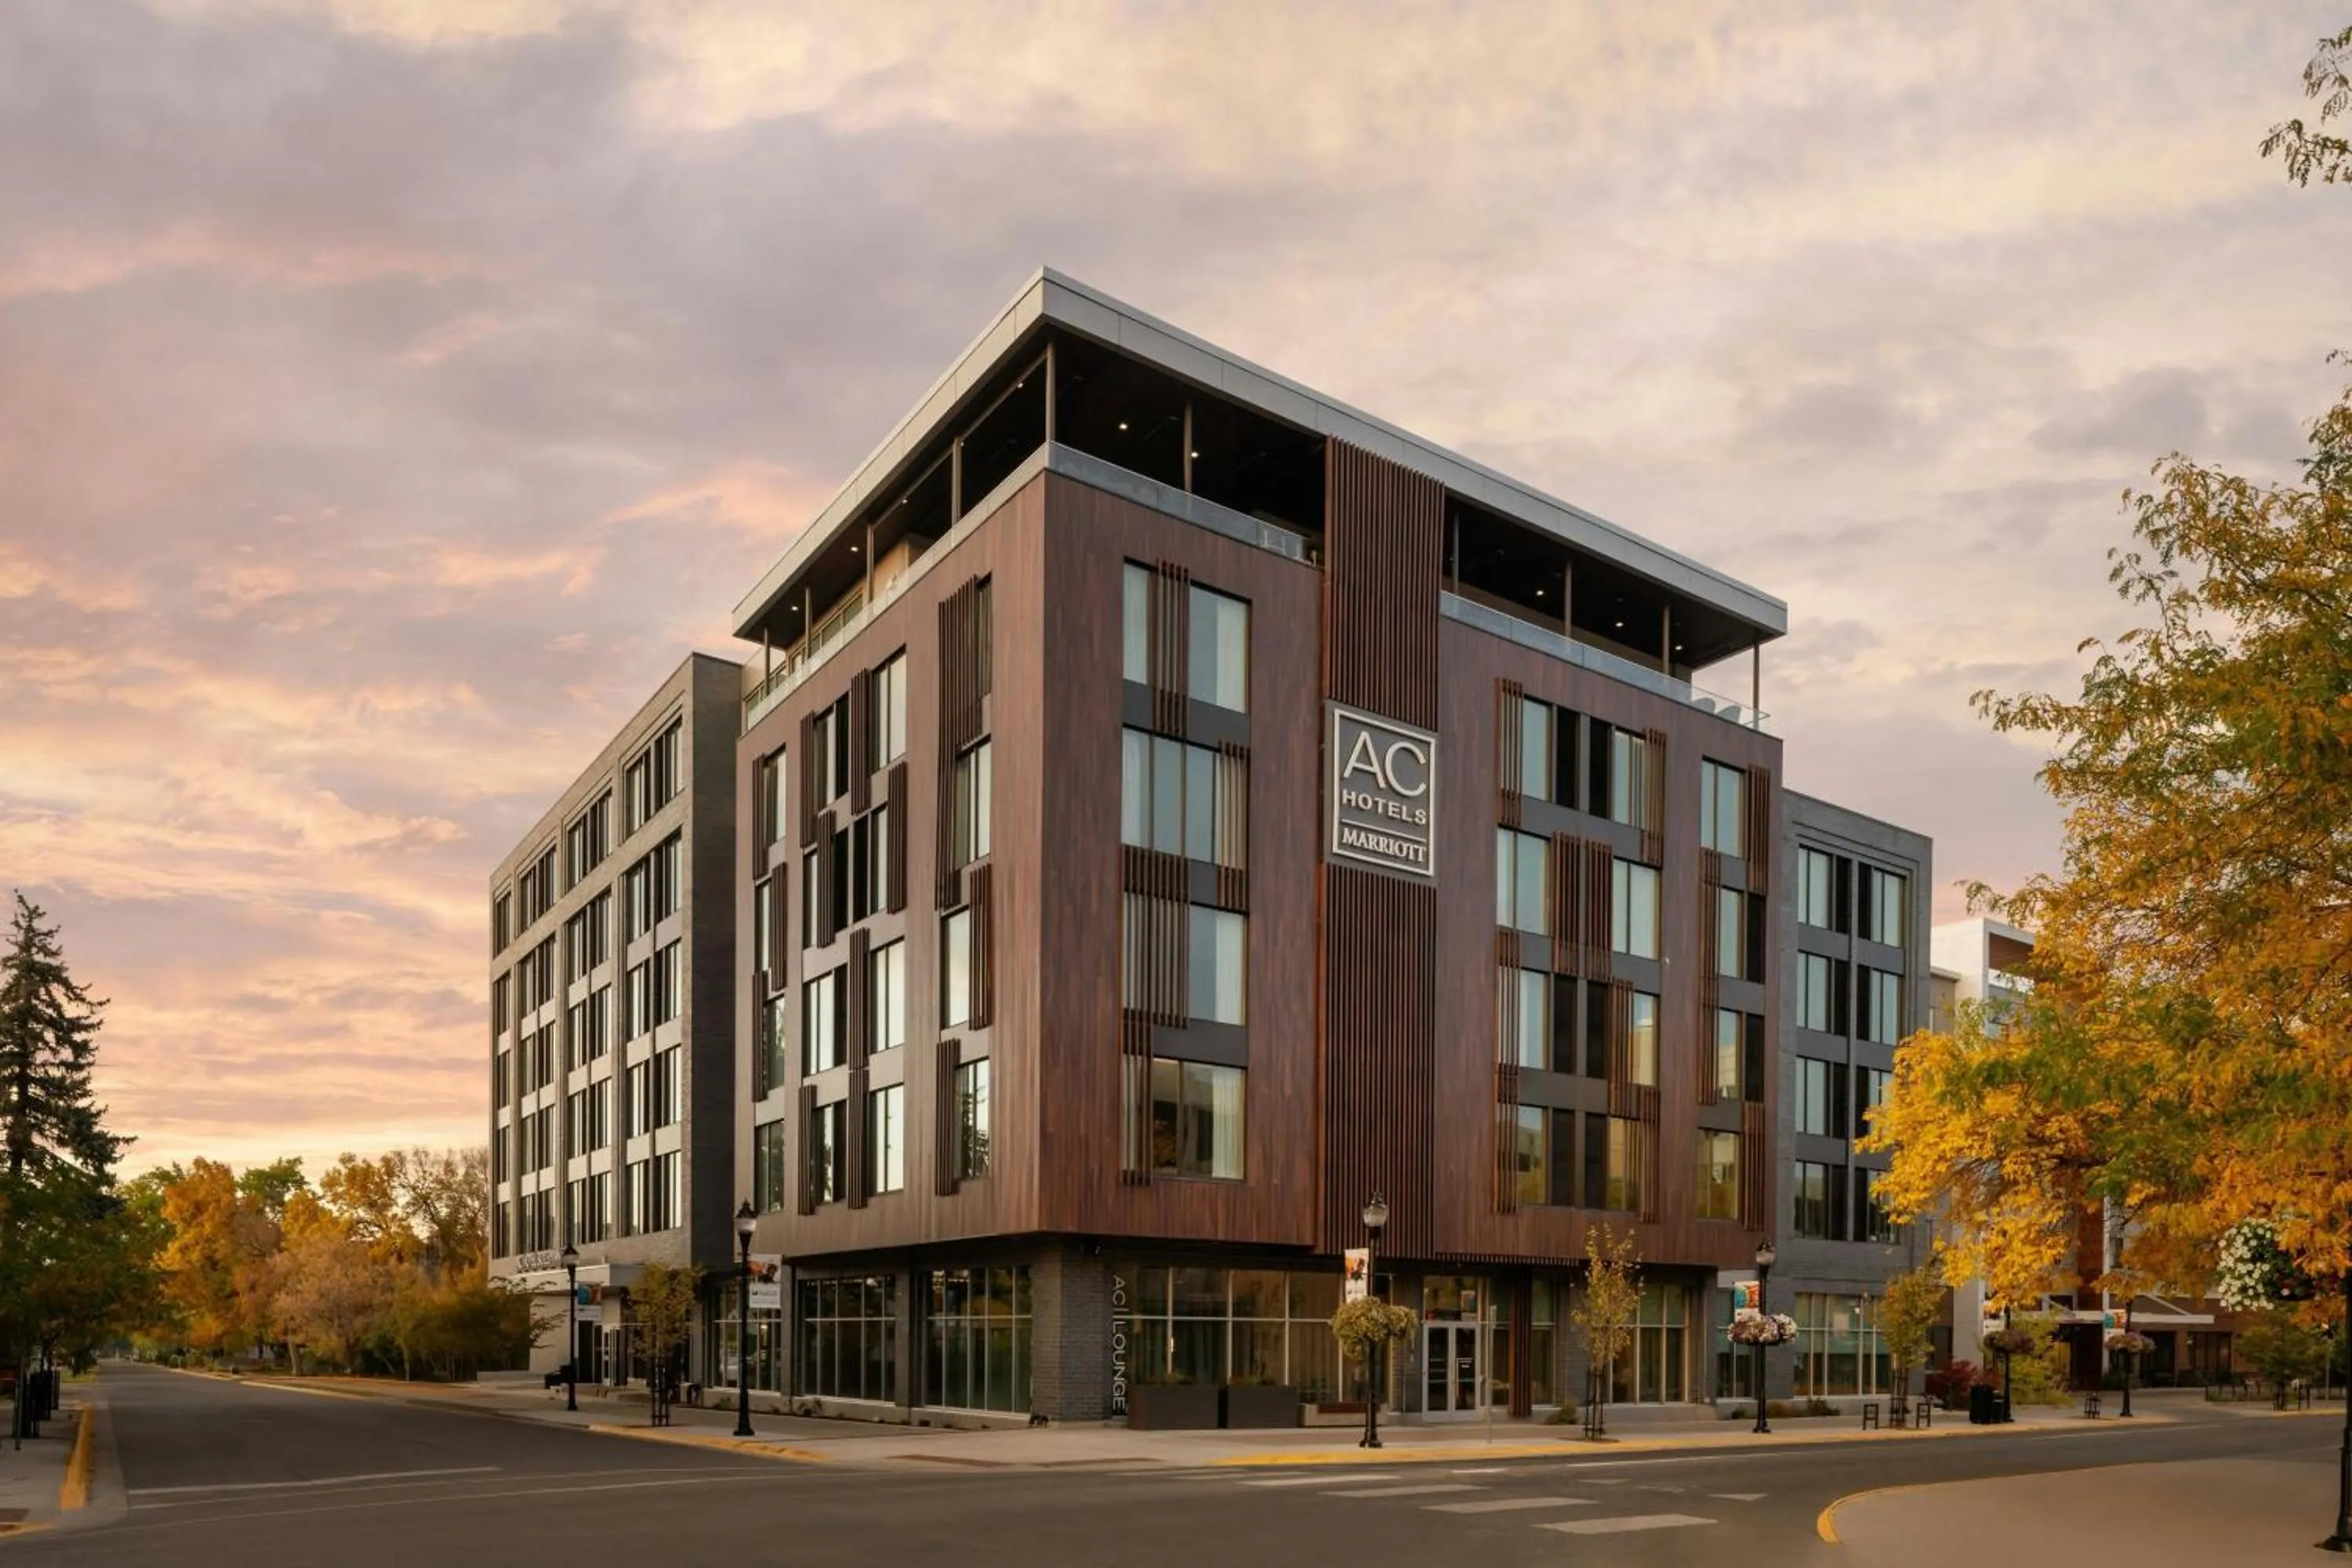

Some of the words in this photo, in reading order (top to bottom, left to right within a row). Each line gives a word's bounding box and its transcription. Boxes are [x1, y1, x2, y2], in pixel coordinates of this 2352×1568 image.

[1343, 730, 1427, 797] AC
[1341, 788, 1427, 826] HOTELS
[1341, 827, 1426, 862] MARRIOTT
[1112, 1275, 1127, 1306] AC
[1112, 1320, 1127, 1411] LOUNGE
